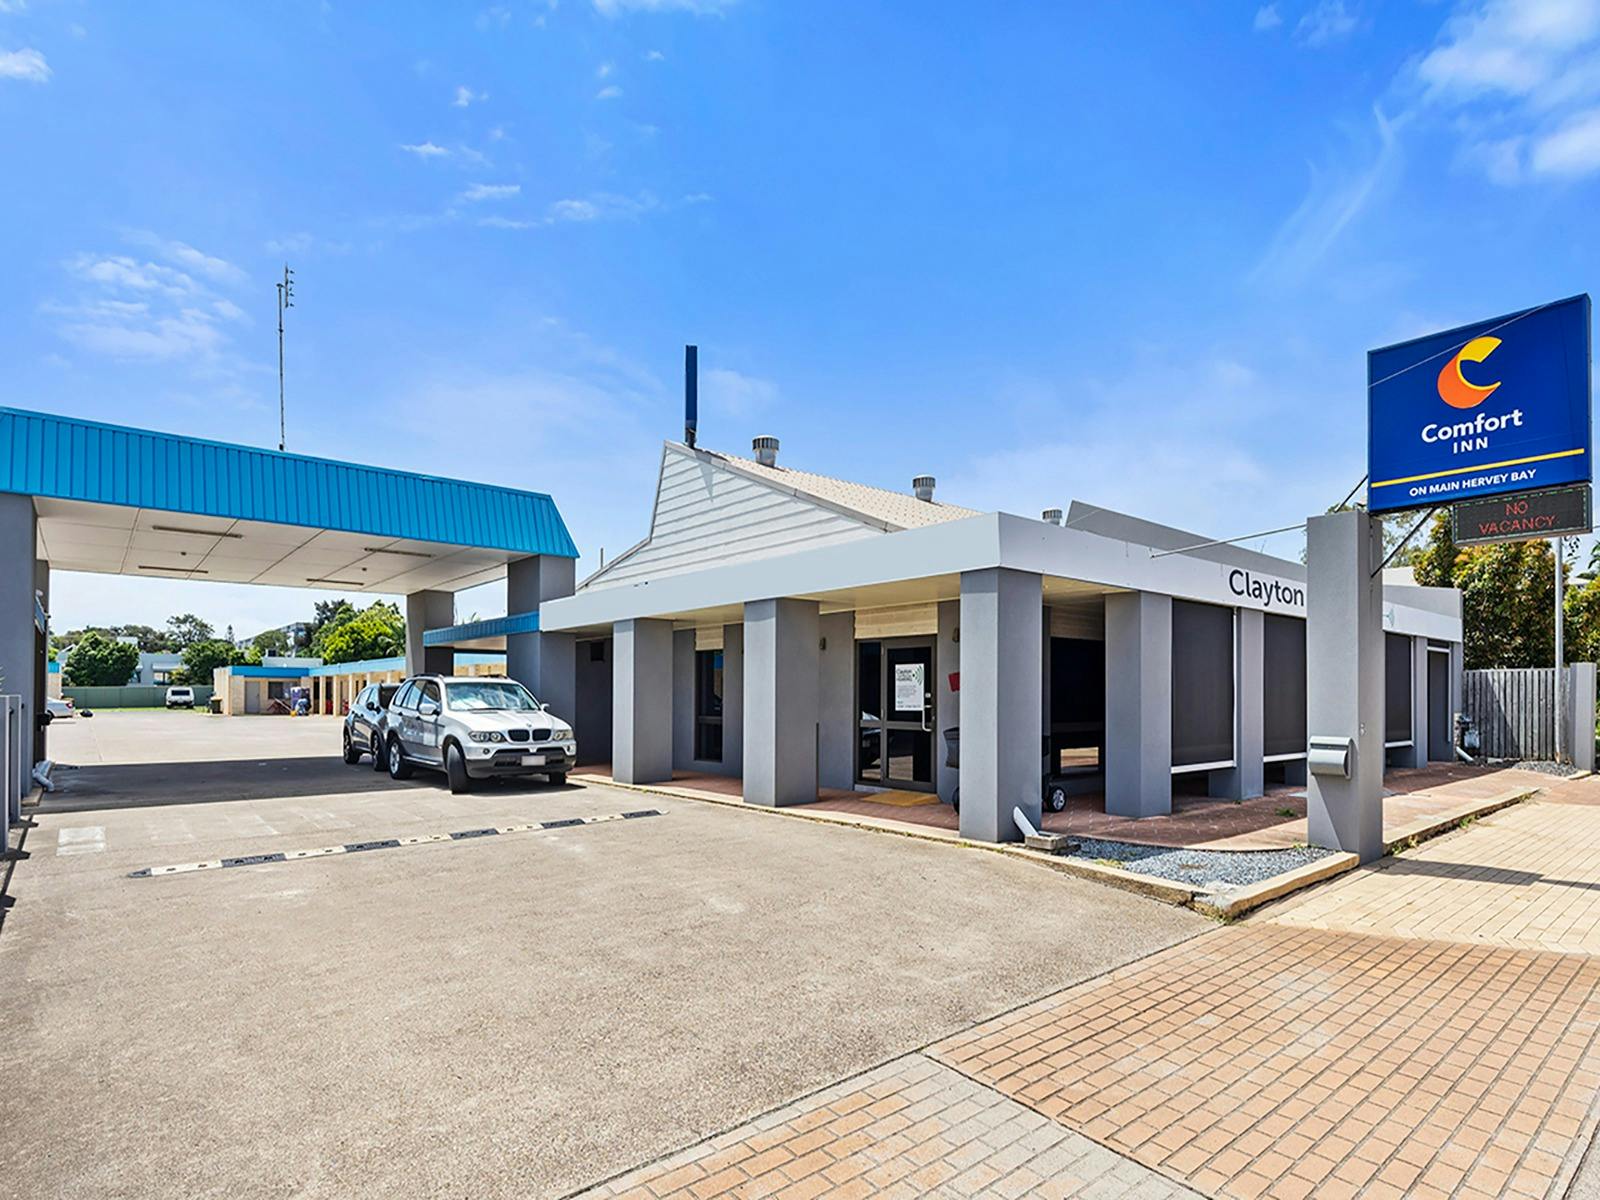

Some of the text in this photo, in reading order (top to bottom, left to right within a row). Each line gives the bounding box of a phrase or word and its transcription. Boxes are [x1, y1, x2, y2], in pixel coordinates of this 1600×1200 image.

[1421, 409, 1523, 443] Comfort
[1453, 437, 1488, 454] INN
[1409, 469, 1537, 497] ON MAIN HERVEY BAY
[1505, 501, 1529, 516] NO
[1479, 516, 1556, 535] VACANCY
[1229, 569, 1304, 607] Clayton
